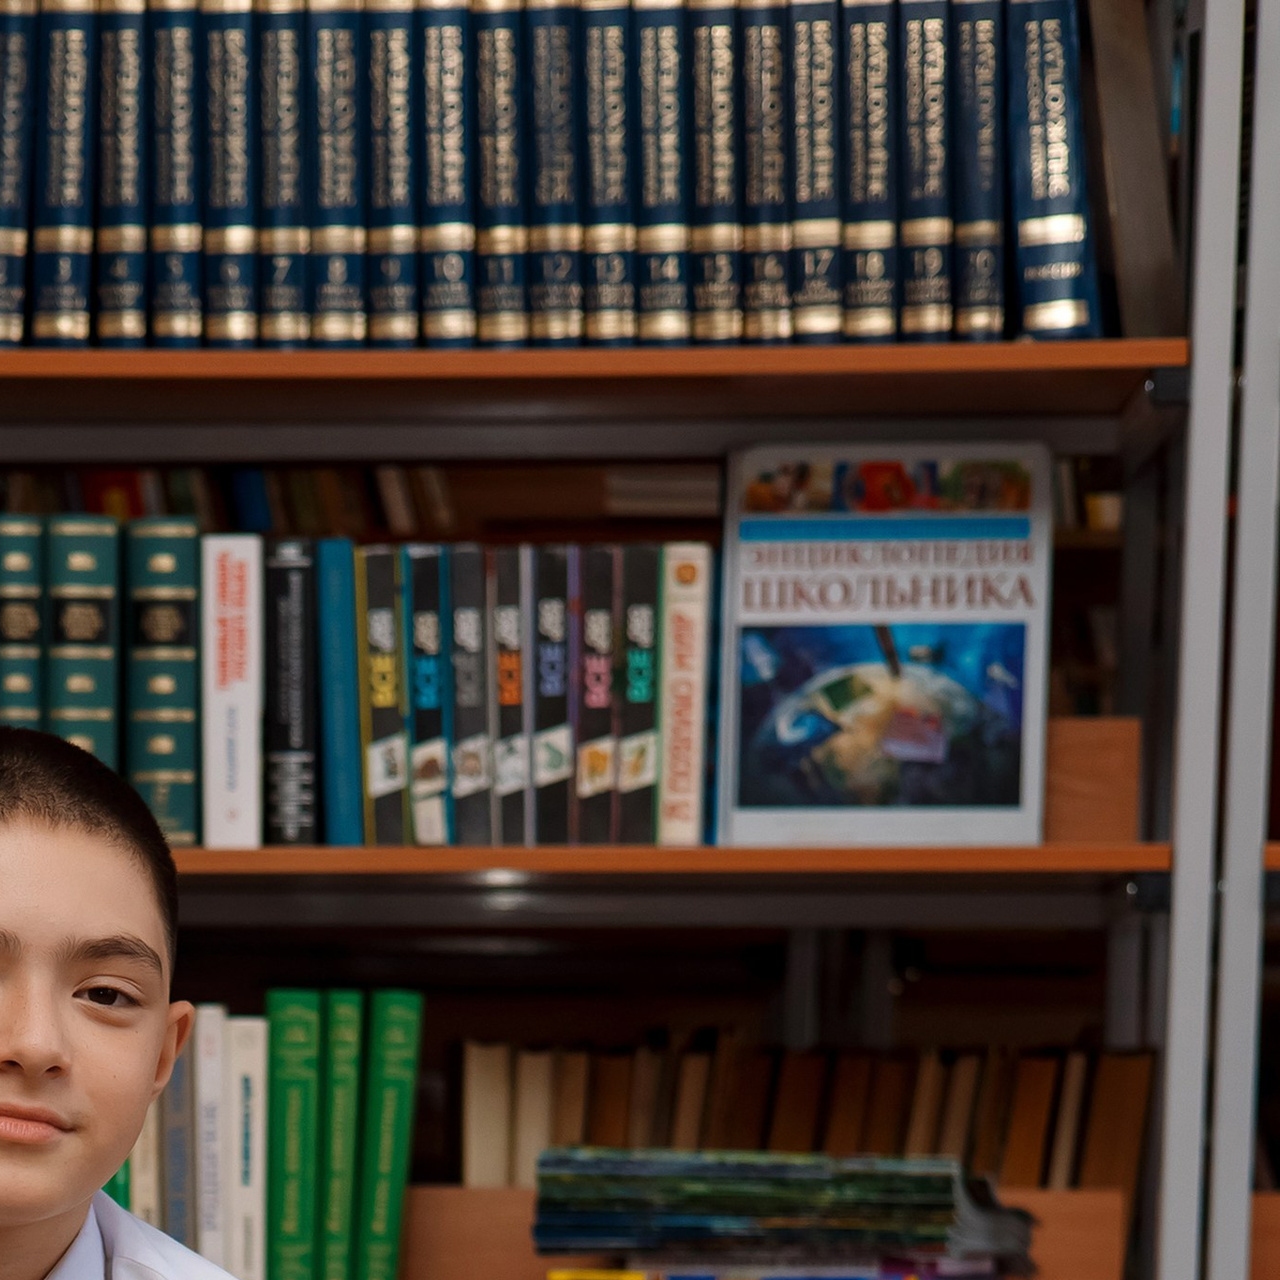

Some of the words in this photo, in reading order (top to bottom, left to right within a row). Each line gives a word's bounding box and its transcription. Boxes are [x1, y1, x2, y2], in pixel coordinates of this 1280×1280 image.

[273, 257, 291, 284] 7
[434, 253, 464, 282] 10
[486, 257, 514, 283] 11
[543, 254, 572, 280] 12
[595, 254, 625, 282] 13
[649, 255, 680, 280] 14
[704, 254, 733, 281] 15
[754, 254, 784, 279] 16
[804, 249, 835, 276] 17
[856, 251, 885, 279] 18
[914, 248, 943, 276] 19
[969, 249, 995, 277] 0
[750, 541, 1033, 567] ЭНЦИКЛОПЕДИЯ
[742, 573, 1036, 612] ШКОЛЬНИКА
[673, 612, 698, 672] МИР
[371, 653, 397, 708] ВСЕ
[415, 655, 439, 709] ВСЕ
[498, 651, 522, 705] ВСЕ
[539, 642, 565, 697] ВСЕ
[584, 654, 611, 708] ВСЕ
[626, 649, 652, 703] ВСЕ
[666, 678, 696, 796] ПОЗНАЮ
